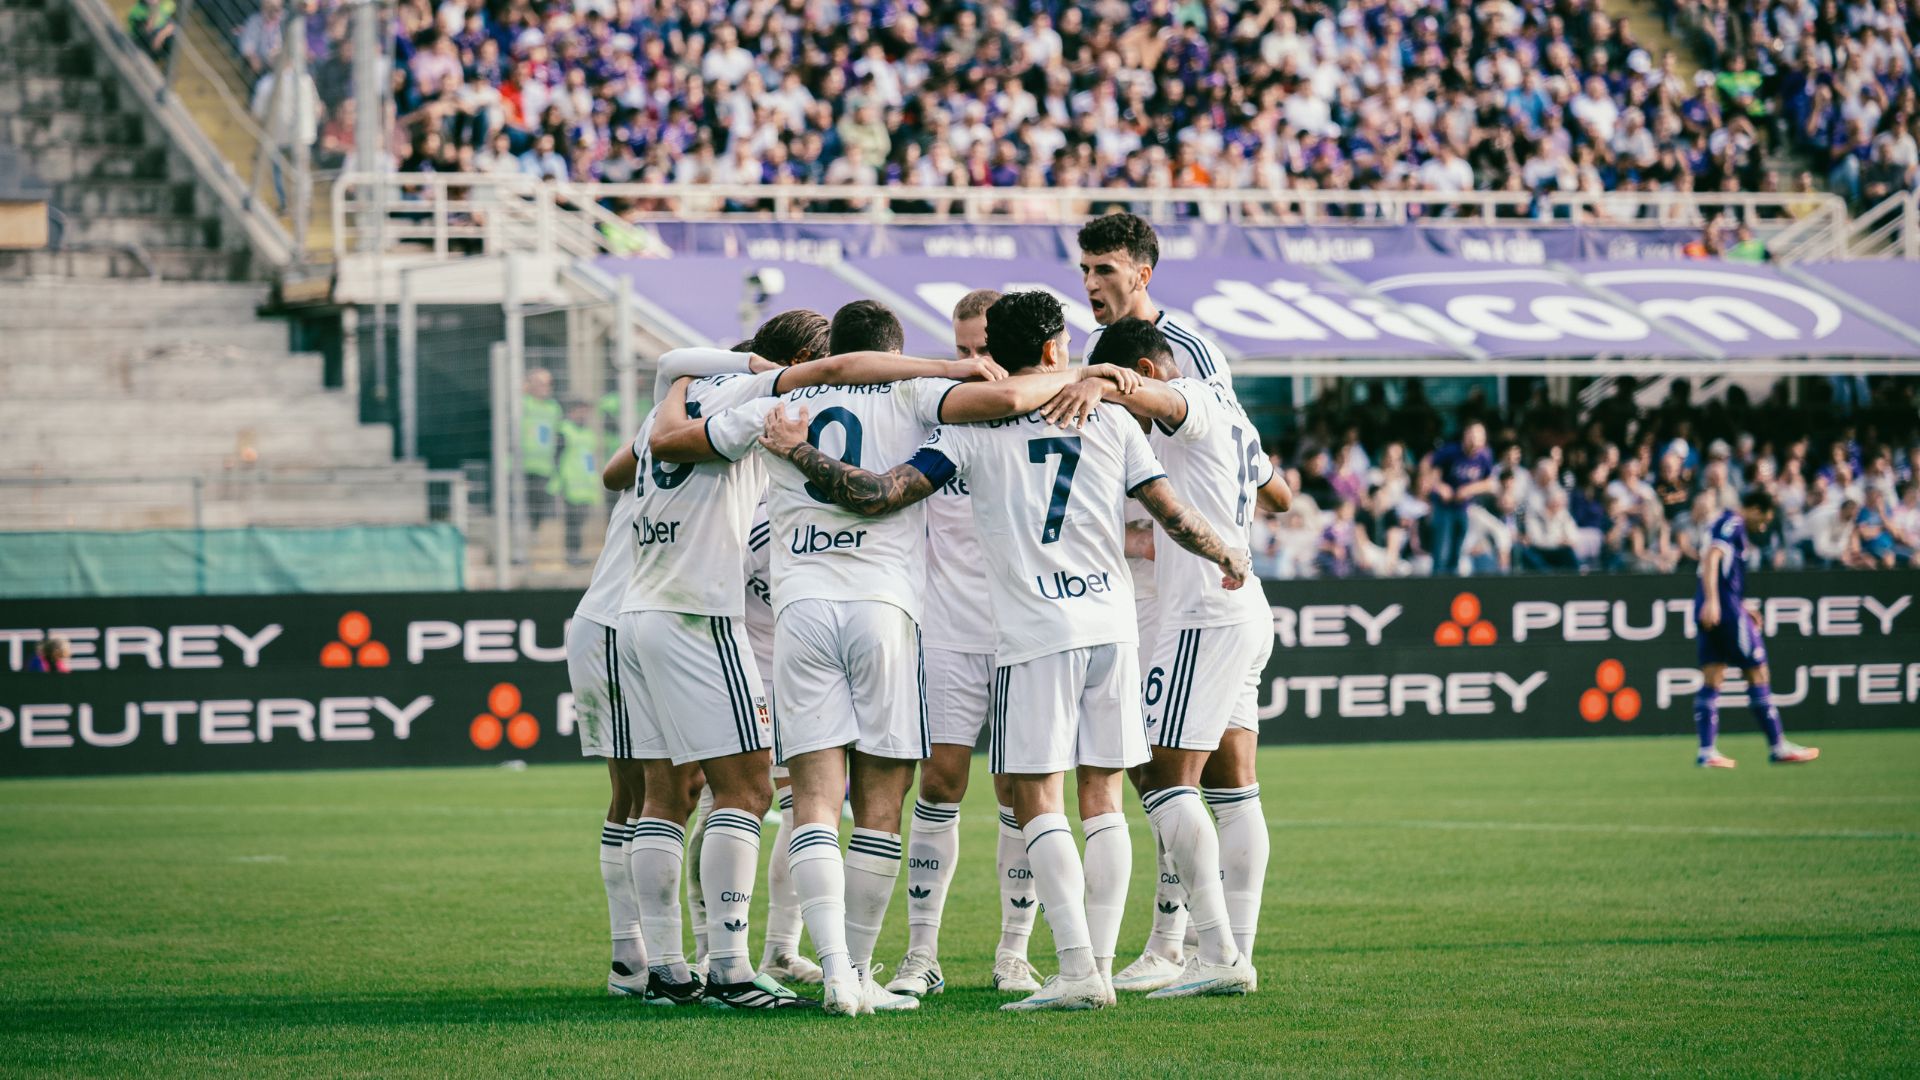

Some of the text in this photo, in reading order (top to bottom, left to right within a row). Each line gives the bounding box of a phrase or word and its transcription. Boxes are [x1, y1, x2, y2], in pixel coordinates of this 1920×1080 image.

[1028, 436, 1082, 544] 7
[632, 516, 681, 547] Uber
[791, 525, 867, 555] Uber
[1036, 571, 1111, 600] Uber
[1512, 595, 1913, 643] PEUTREY
[0, 694, 433, 749] EUTEREY
[1656, 662, 1920, 709] PEUTE
